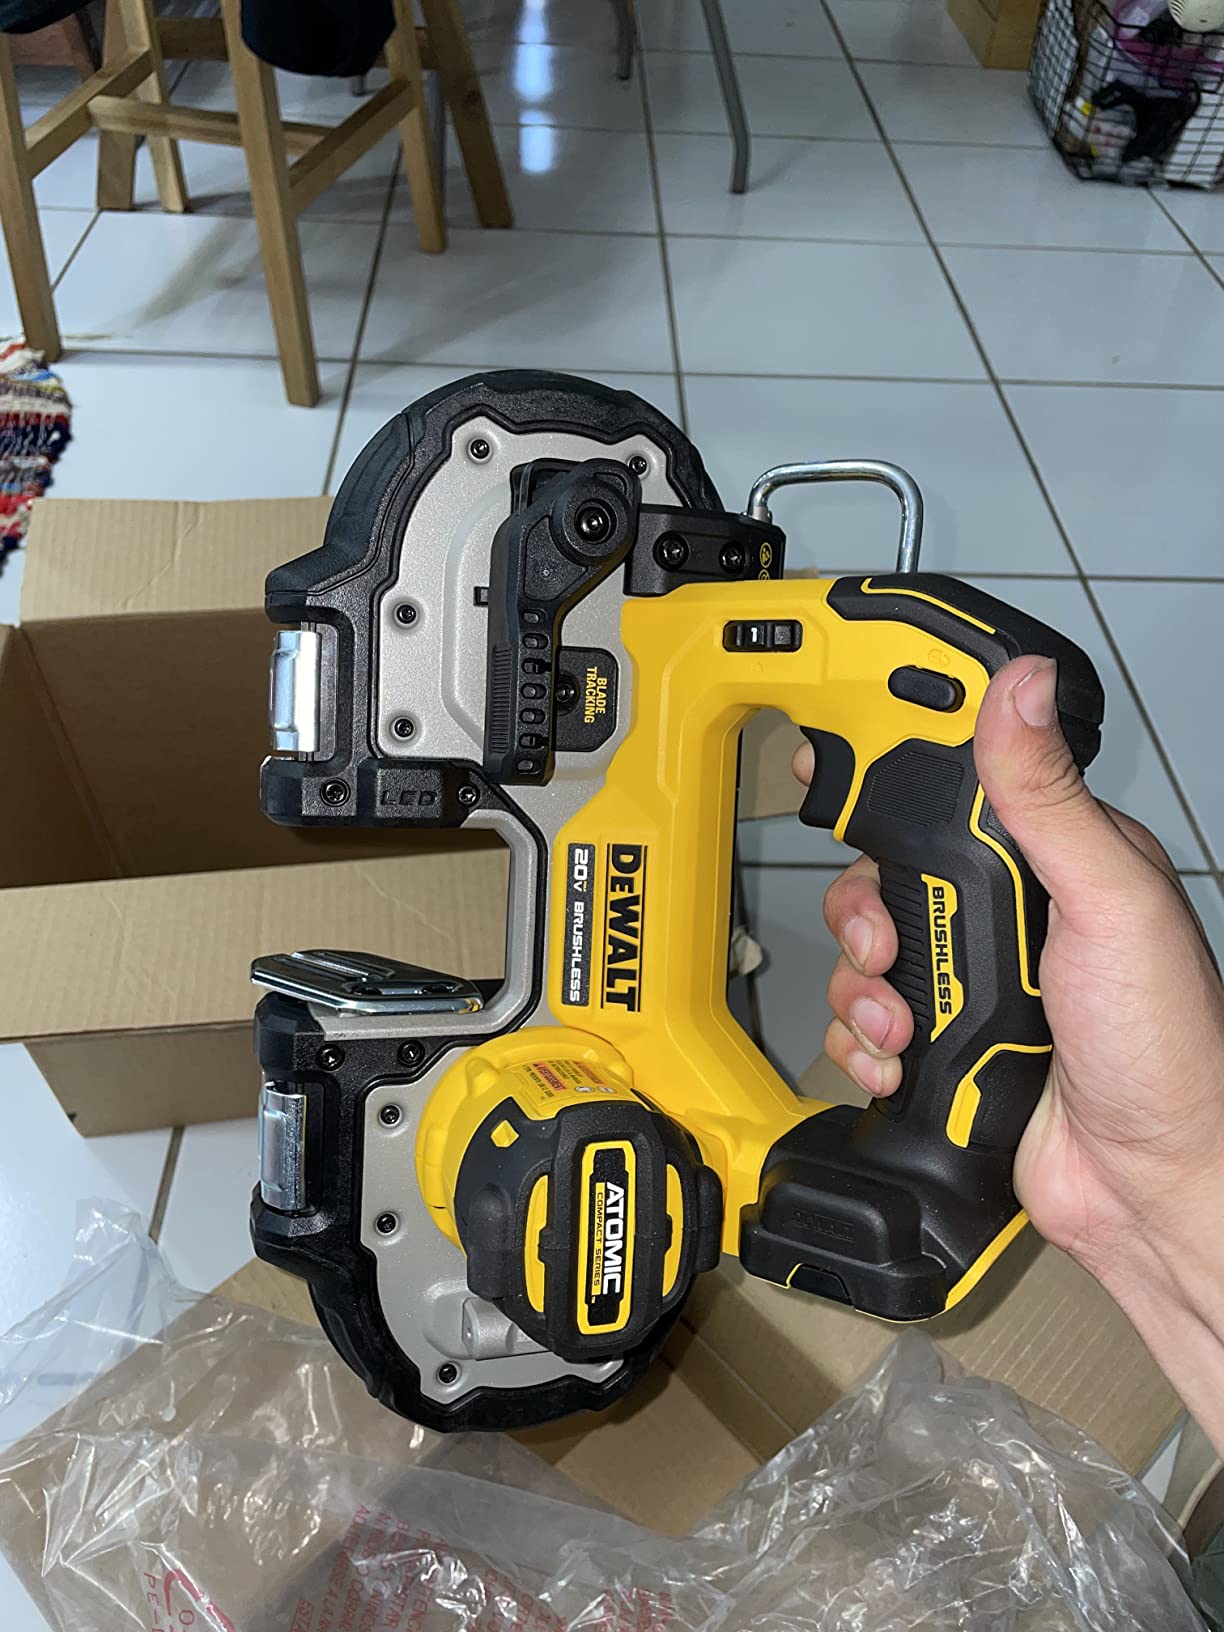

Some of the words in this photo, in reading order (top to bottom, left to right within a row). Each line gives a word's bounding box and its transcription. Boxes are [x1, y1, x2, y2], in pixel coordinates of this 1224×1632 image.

[584, 666, 598, 723] TRACKING
[595, 677, 607, 714] BLADE
[380, 789, 438, 806] LED
[569, 901, 585, 1002] BRUSHLESS
[605, 843, 643, 1012] DEWALT
[932, 886, 952, 1015] BRUSHLESS
[594, 1192, 604, 1243] COMPACT
[602, 1181, 625, 1295] ATOMIC
[593, 1248, 602, 1286] SERIES
